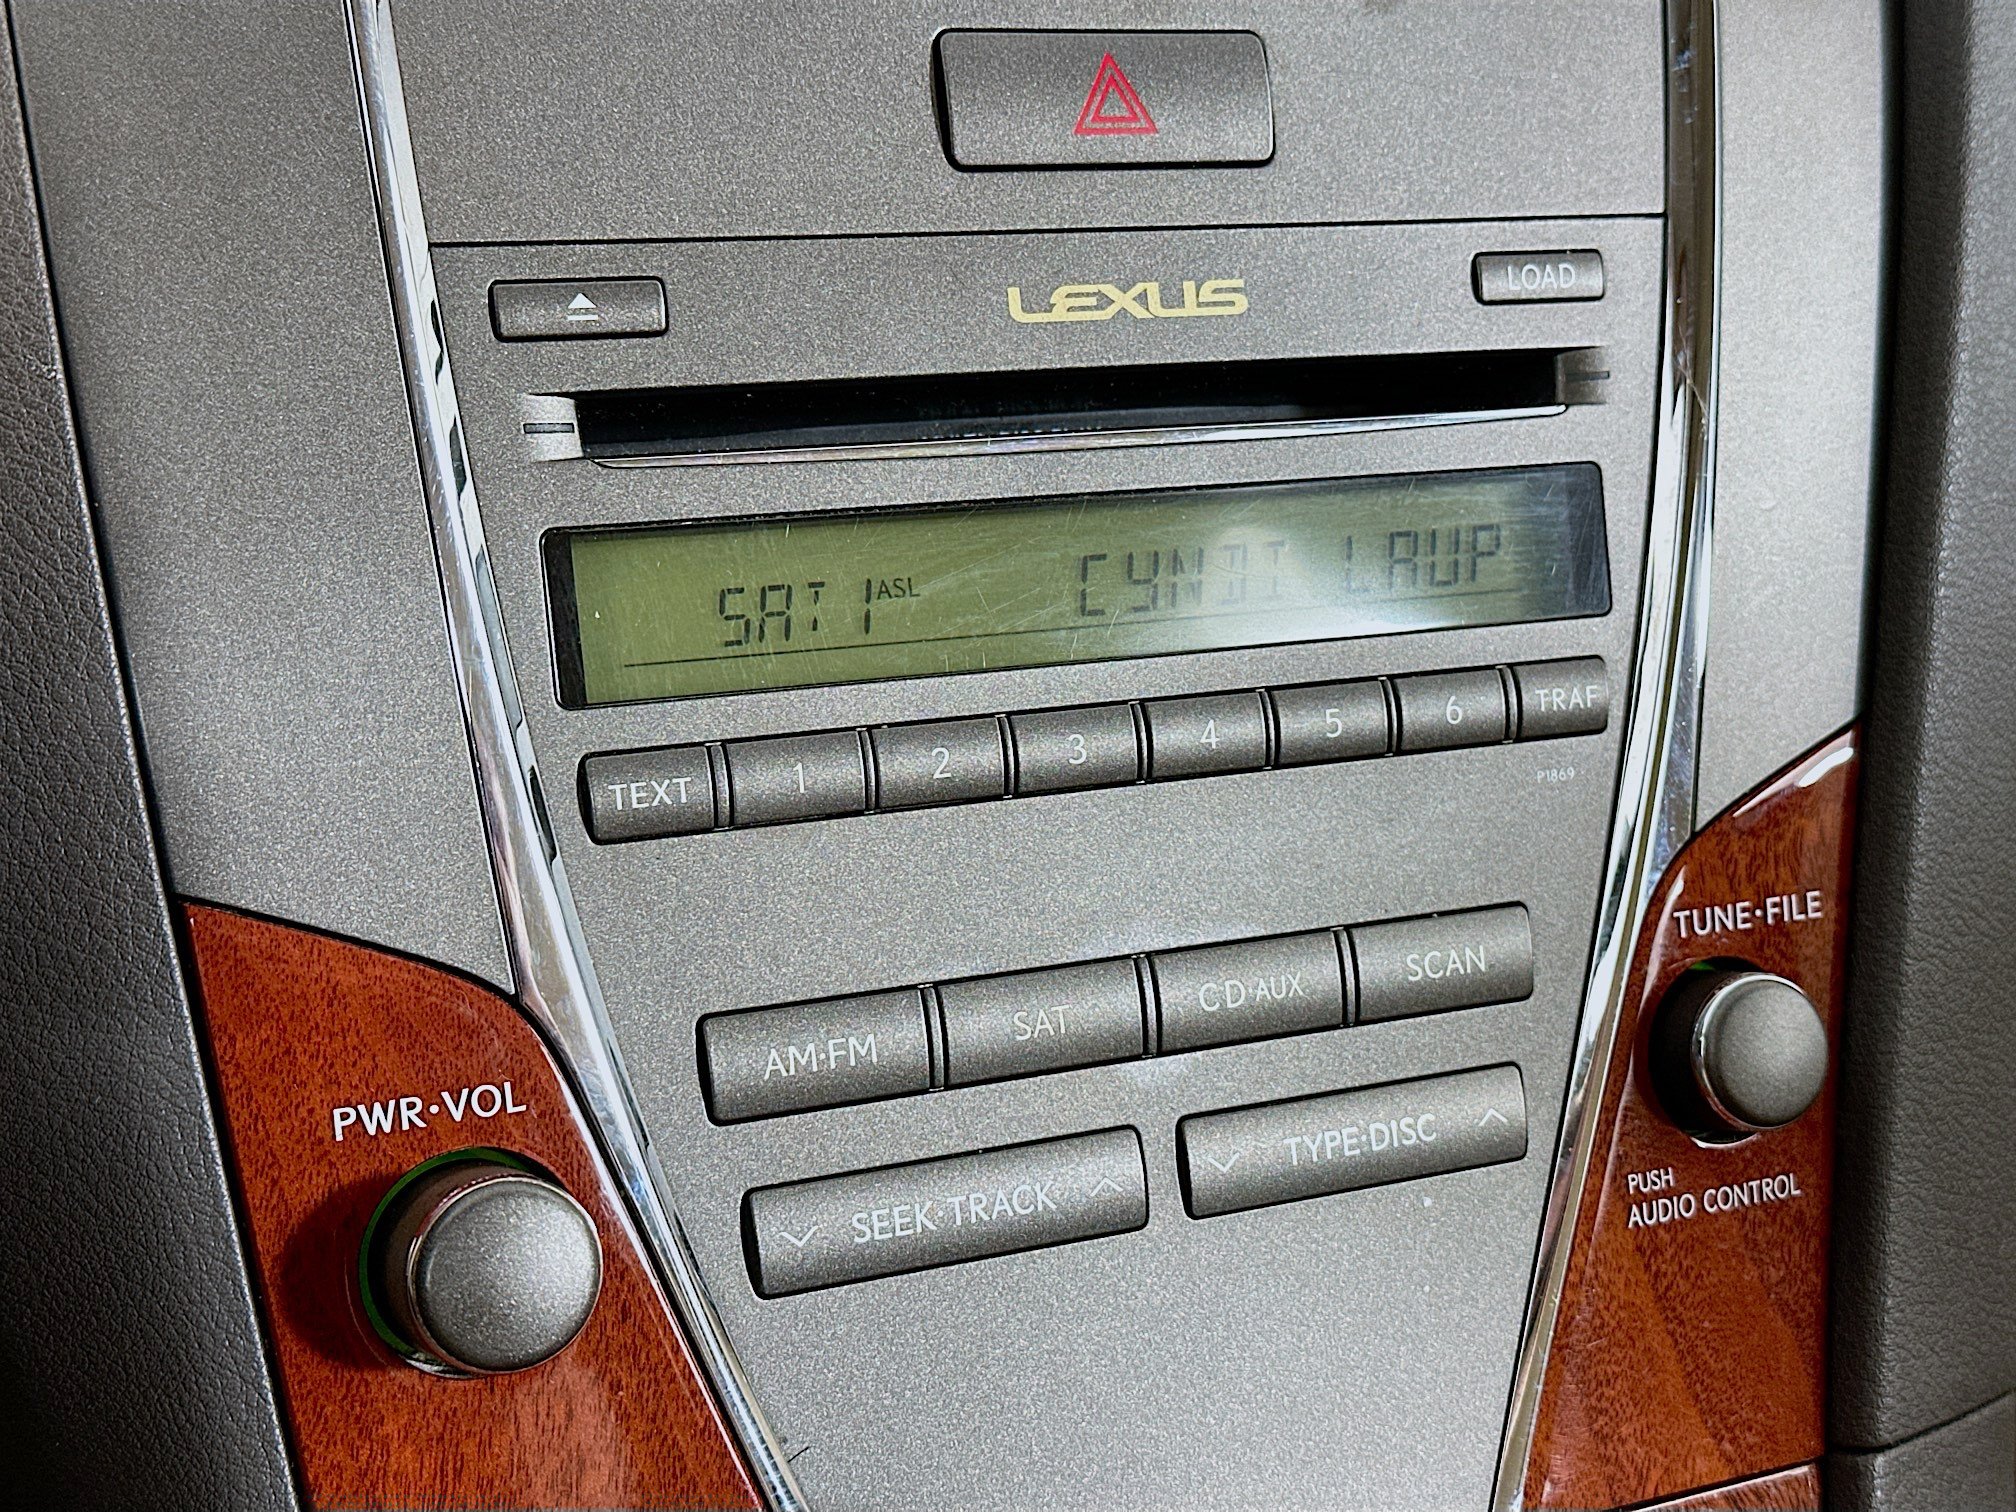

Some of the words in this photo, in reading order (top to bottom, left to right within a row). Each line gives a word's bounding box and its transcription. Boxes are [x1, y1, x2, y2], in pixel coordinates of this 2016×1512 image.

[1508, 262, 1576, 290] LOAD
[1007, 279, 1249, 324] LEXUS
[1345, 523, 1501, 594] LAUP
[877, 577, 921, 600] ASL
[1445, 695, 1464, 725] 6
[1534, 684, 1598, 712] TRAF
[1199, 719, 1220, 749] 4
[1324, 708, 1343, 738] 5
[931, 747, 952, 779] 2
[1066, 733, 1088, 765] 3
[793, 763, 806, 794] 1
[1536, 766, 1576, 783] P1869
[607, 777, 692, 812] TEXT
[1405, 945, 1486, 982] SCAN
[1013, 1005, 1070, 1041] SAT
[1627, 1167, 1675, 1194] PUSH
[1628, 1192, 1697, 1229] AUDIO
[1703, 1172, 1801, 1214] CONTROL
